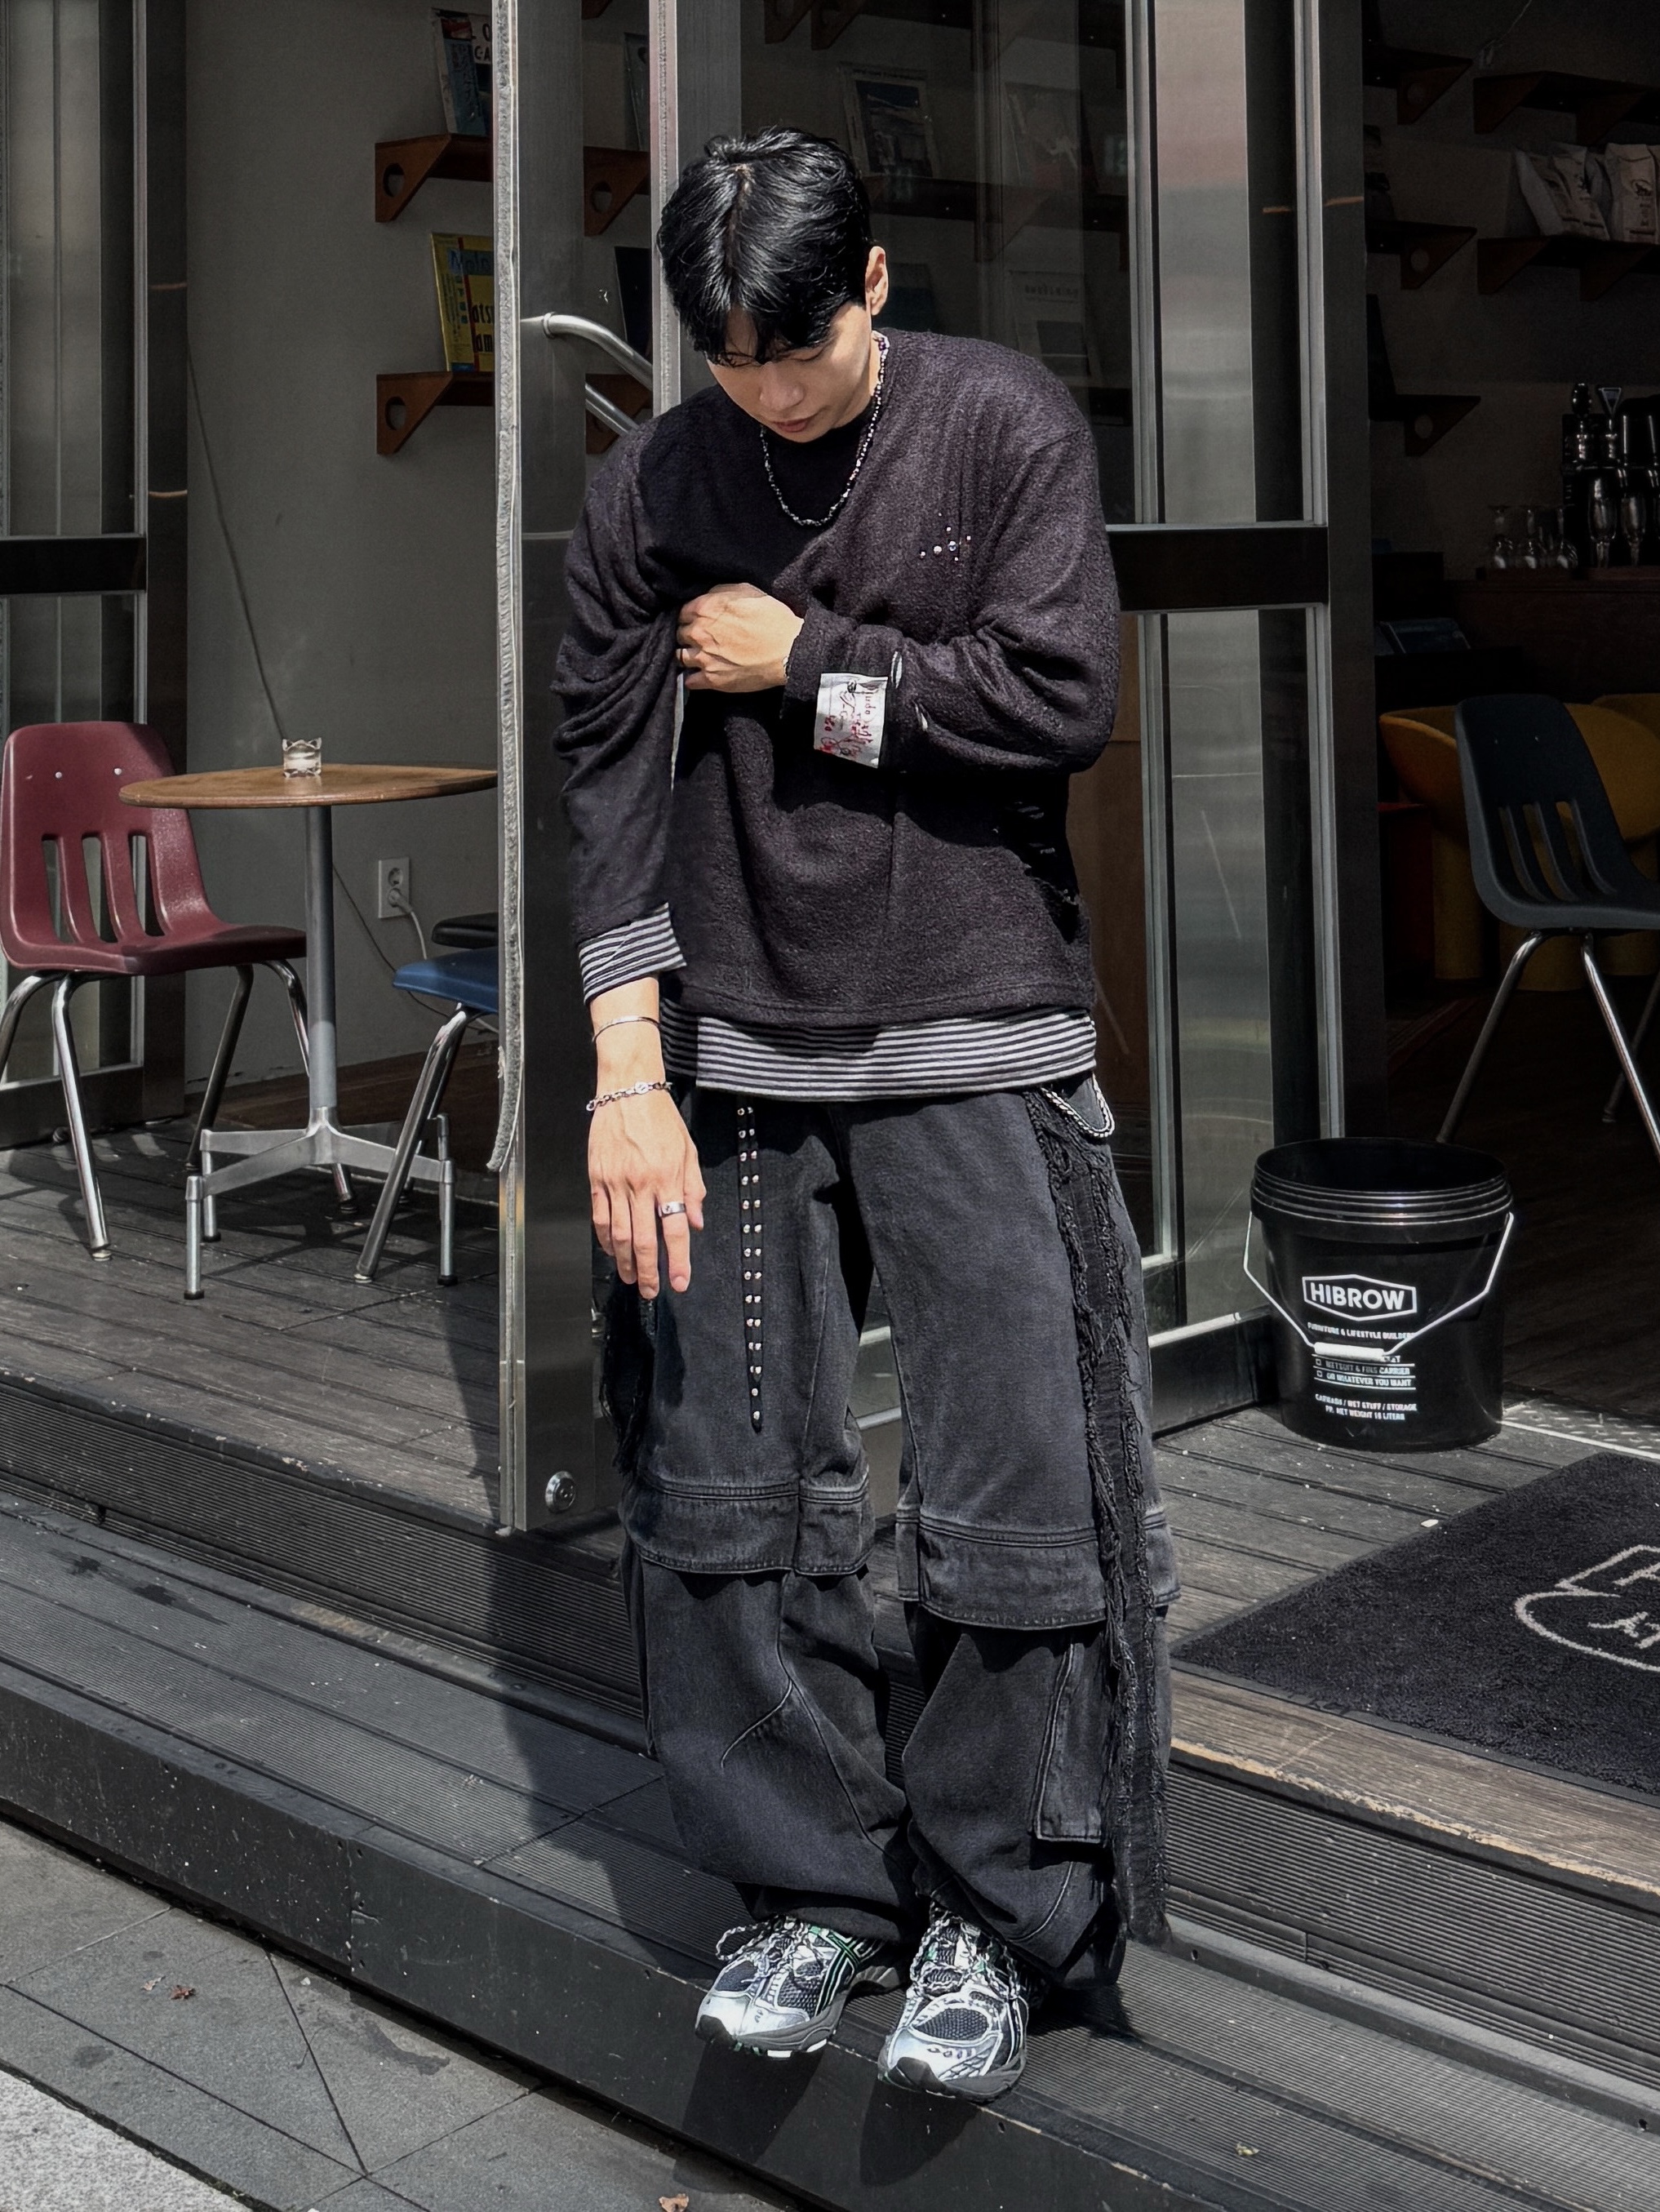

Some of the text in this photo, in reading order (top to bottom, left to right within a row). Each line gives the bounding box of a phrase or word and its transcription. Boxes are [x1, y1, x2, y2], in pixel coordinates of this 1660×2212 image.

[1310, 1282, 1405, 1310] HIBROW
[1337, 1374, 1374, 1385] WHATEVER
[1374, 1378, 1389, 1386] YOU
[1391, 1379, 1412, 1387] WANT
